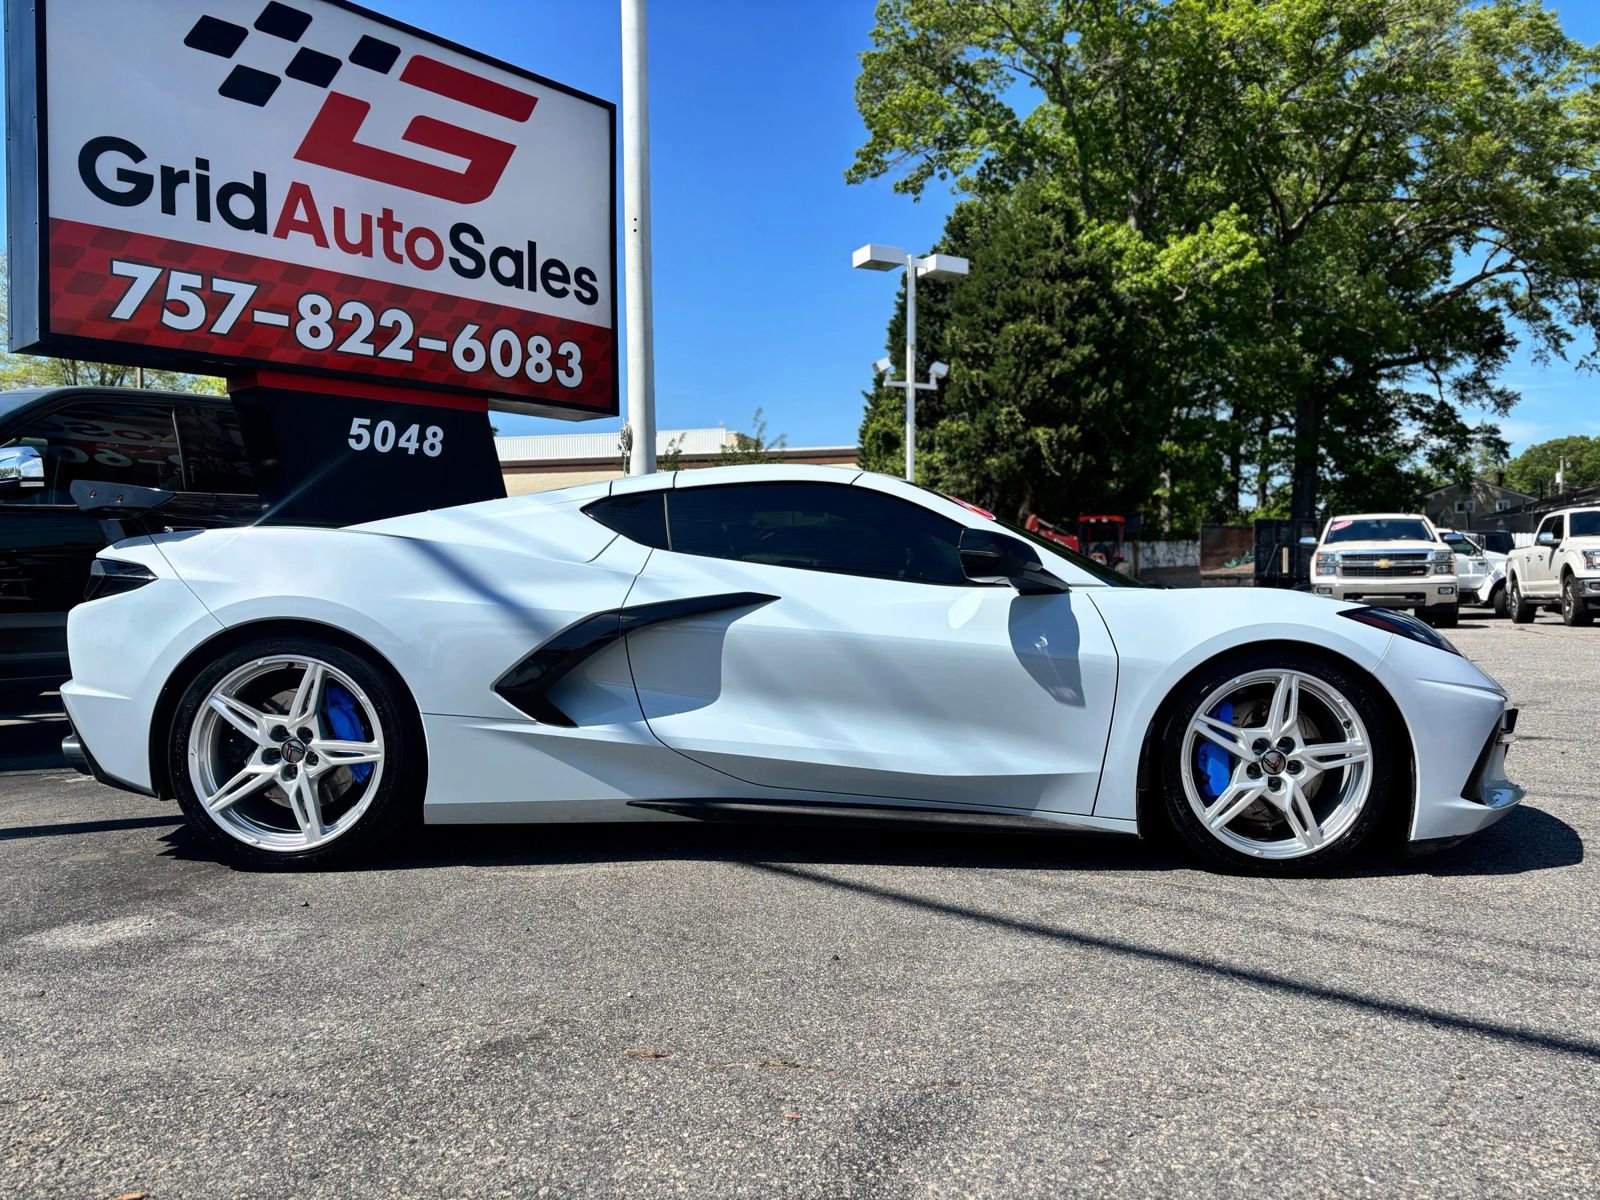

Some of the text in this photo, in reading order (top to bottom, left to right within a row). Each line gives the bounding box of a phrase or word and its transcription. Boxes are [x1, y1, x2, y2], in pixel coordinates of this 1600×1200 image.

[77, 135, 600, 305] GridAutoSales
[109, 258, 585, 389] 757-822-6083
[347, 417, 445, 458] 5048
